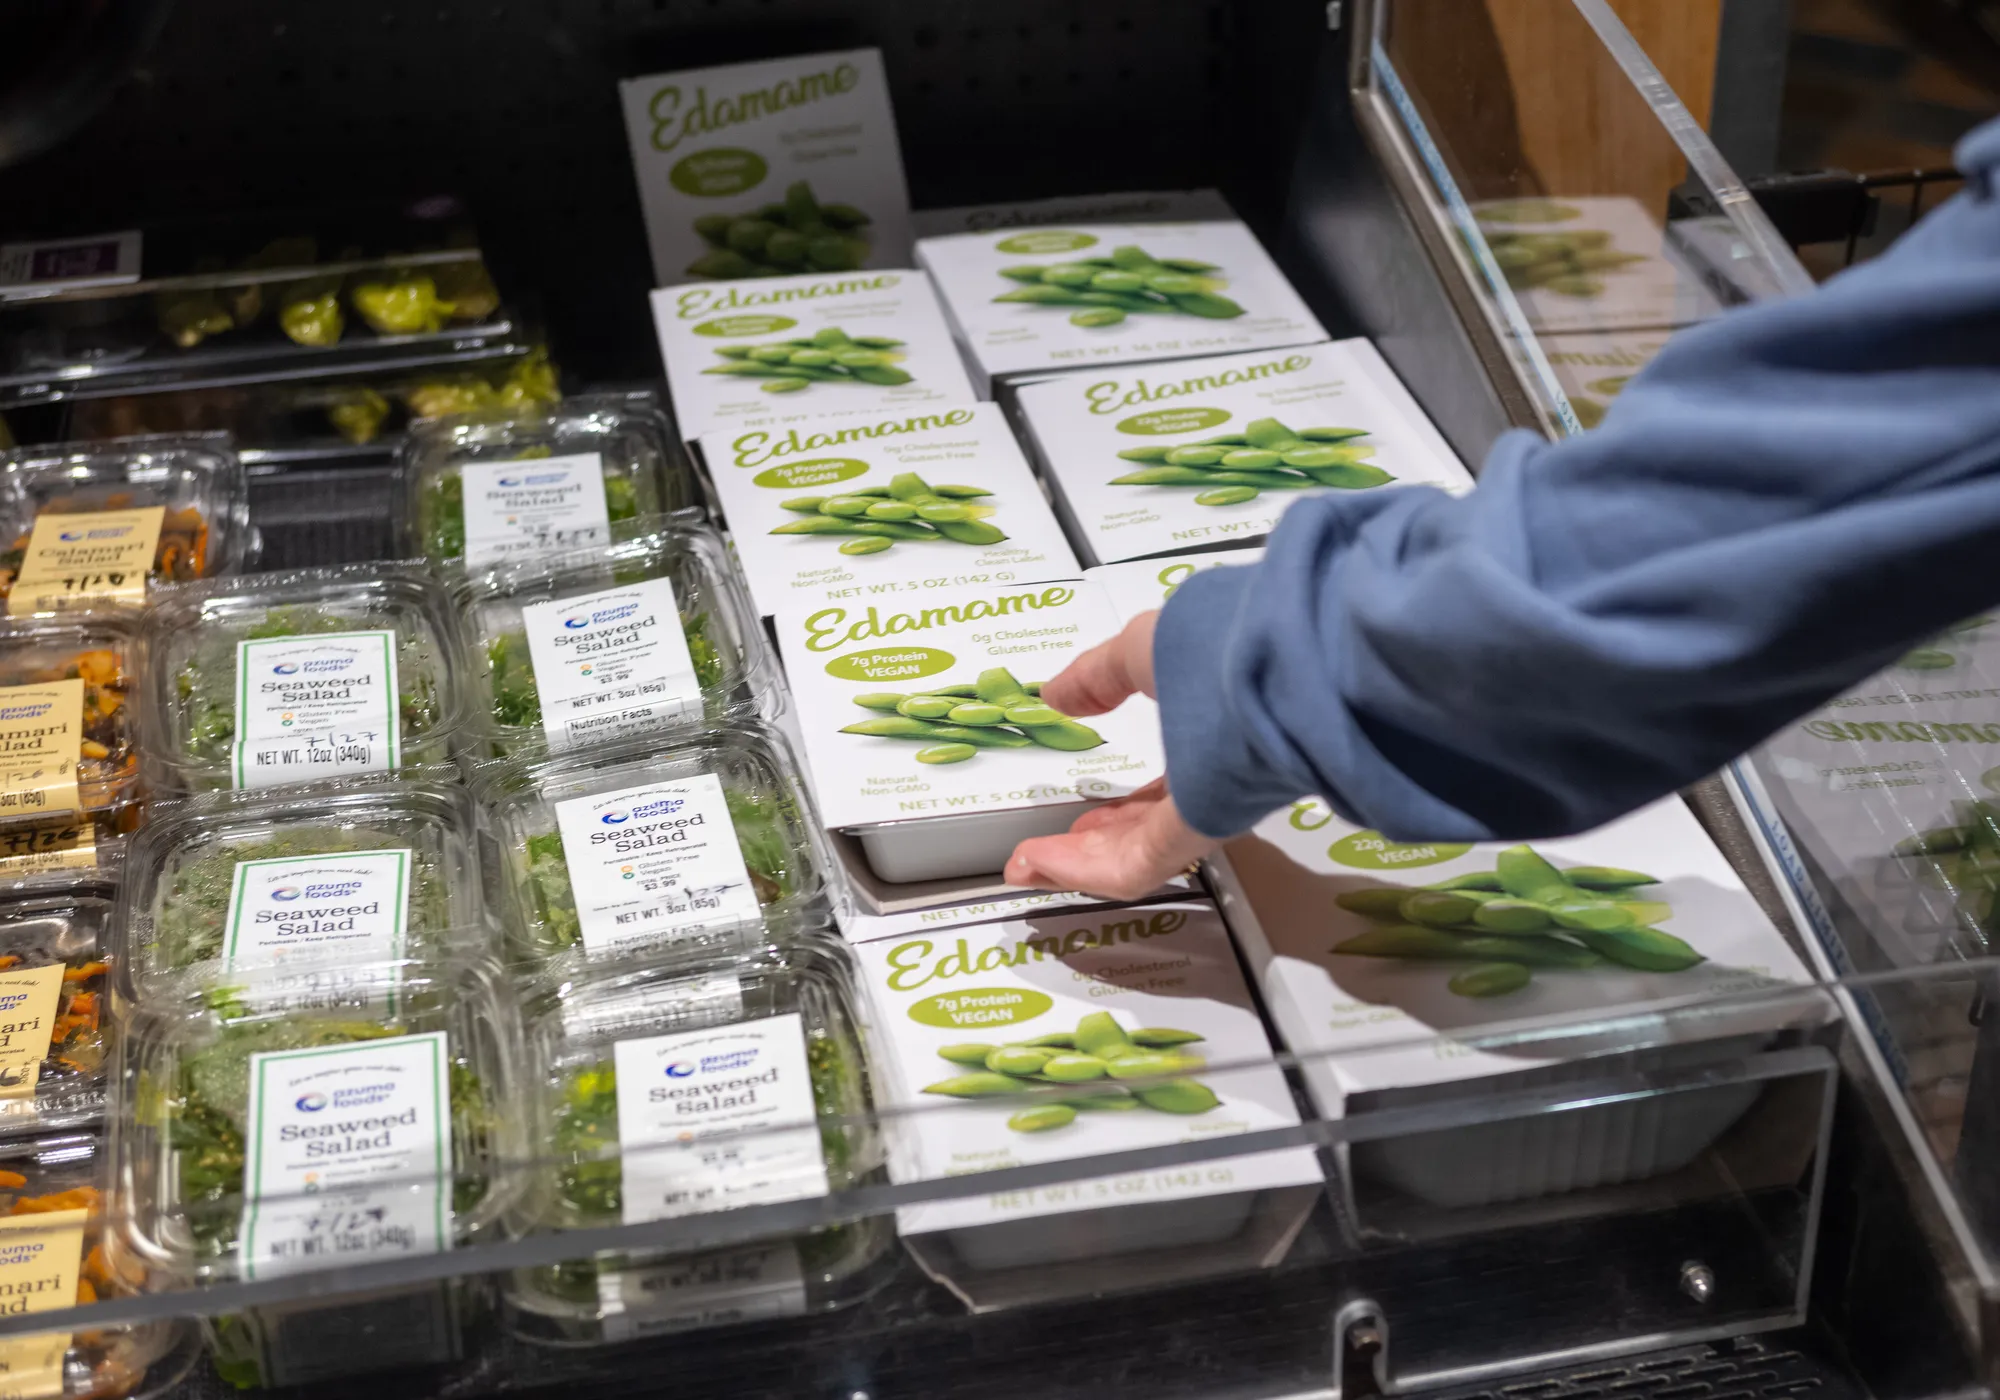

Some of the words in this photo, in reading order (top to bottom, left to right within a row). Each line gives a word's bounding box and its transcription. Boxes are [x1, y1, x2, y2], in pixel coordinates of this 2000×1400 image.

[648, 61, 860, 151] Edamame
[677, 276, 901, 319] Edamame
[1085, 354, 1312, 415] Edamame
[1154, 421, 1200, 433] VEGAN
[732, 410, 974, 468] Edamame
[776, 468, 791, 479] 7g
[794, 460, 845, 476] Protein
[788, 472, 839, 486] VEGAN
[1171, 527, 1207, 542] NET
[1211, 521, 1259, 537] WT.
[974, 557, 1012, 568] Clean
[1013, 553, 1046, 565] Label
[791, 571, 855, 588] Non-GMO
[796, 565, 843, 580] Natural
[827, 585, 861, 601] NET
[866, 582, 903, 598] WT.
[908, 580, 918, 591] 5
[923, 576, 950, 588] OZ
[954, 573, 991, 587] (142
[994, 570, 1016, 584] G)
[804, 586, 1075, 653] Edamame
[554, 615, 658, 647] Seaweed
[971, 632, 992, 645] 0g
[996, 624, 1080, 642] Cholesterol
[576, 632, 640, 655] Salad
[988, 643, 1038, 657] Gluten
[1040, 638, 1074, 652] Free
[850, 656, 870, 668] 7g
[873, 650, 929, 665] Protein
[864, 664, 920, 679] VEGAN
[261, 674, 372, 693] Seaweed
[282, 687, 351, 703] Salad
[572, 696, 593, 709] NET
[596, 693, 616, 703] WT.
[618, 688, 637, 700] 3oz
[637, 682, 667, 698] (85g)
[571, 714, 620, 730] Nutrition
[622, 707, 653, 721] Facts
[257, 751, 278, 766] NET
[282, 749, 303, 764] WT.
[306, 747, 333, 763] 12oz
[335, 746, 371, 766] (340g)
[1075, 753, 1129, 767] Healthy
[1067, 763, 1105, 777] Clean
[1106, 759, 1146, 773] Label
[860, 782, 931, 798] Non-GMO
[866, 774, 920, 788] Natural
[632, 799, 684, 812] azuma
[899, 800, 936, 813] NET
[938, 794, 985, 811] WT.
[990, 792, 1001, 803] 5
[1006, 788, 1038, 802] OZ
[1042, 782, 1085, 799] (142
[1088, 779, 1112, 795] G)
[633, 806, 677, 819] foods
[590, 813, 706, 845] Seaweed
[615, 829, 688, 853] Salad
[1352, 838, 1385, 851] 22g
[1376, 846, 1438, 864] VEGAN
[305, 889, 352, 899] foods
[306, 881, 363, 892] azuma
[644, 879, 677, 891] $3.99
[255, 902, 381, 924] Seaweed
[616, 912, 641, 925] NET
[643, 908, 664, 920] WT.
[667, 904, 688, 915] 3oz
[690, 896, 721, 912] (85g)
[920, 908, 961, 923] NET
[965, 903, 1004, 916] WT.
[1011, 900, 1021, 909] 5
[277, 917, 354, 936] Salad
[886, 910, 1188, 991] Edamame
[1096, 956, 1193, 980] Cholesterol
[1088, 981, 1147, 998] Gluten
[1149, 976, 1187, 990] Free
[936, 996, 955, 1012] 7g
[959, 991, 1023, 1009] Protein
[951, 1008, 1014, 1026] VEGAN
[649, 1067, 779, 1103] Seaweed
[676, 1089, 757, 1115] Salad
[280, 1106, 417, 1142] Seaweed
[306, 1131, 391, 1158] Salad
[991, 1193, 1039, 1210] NET
